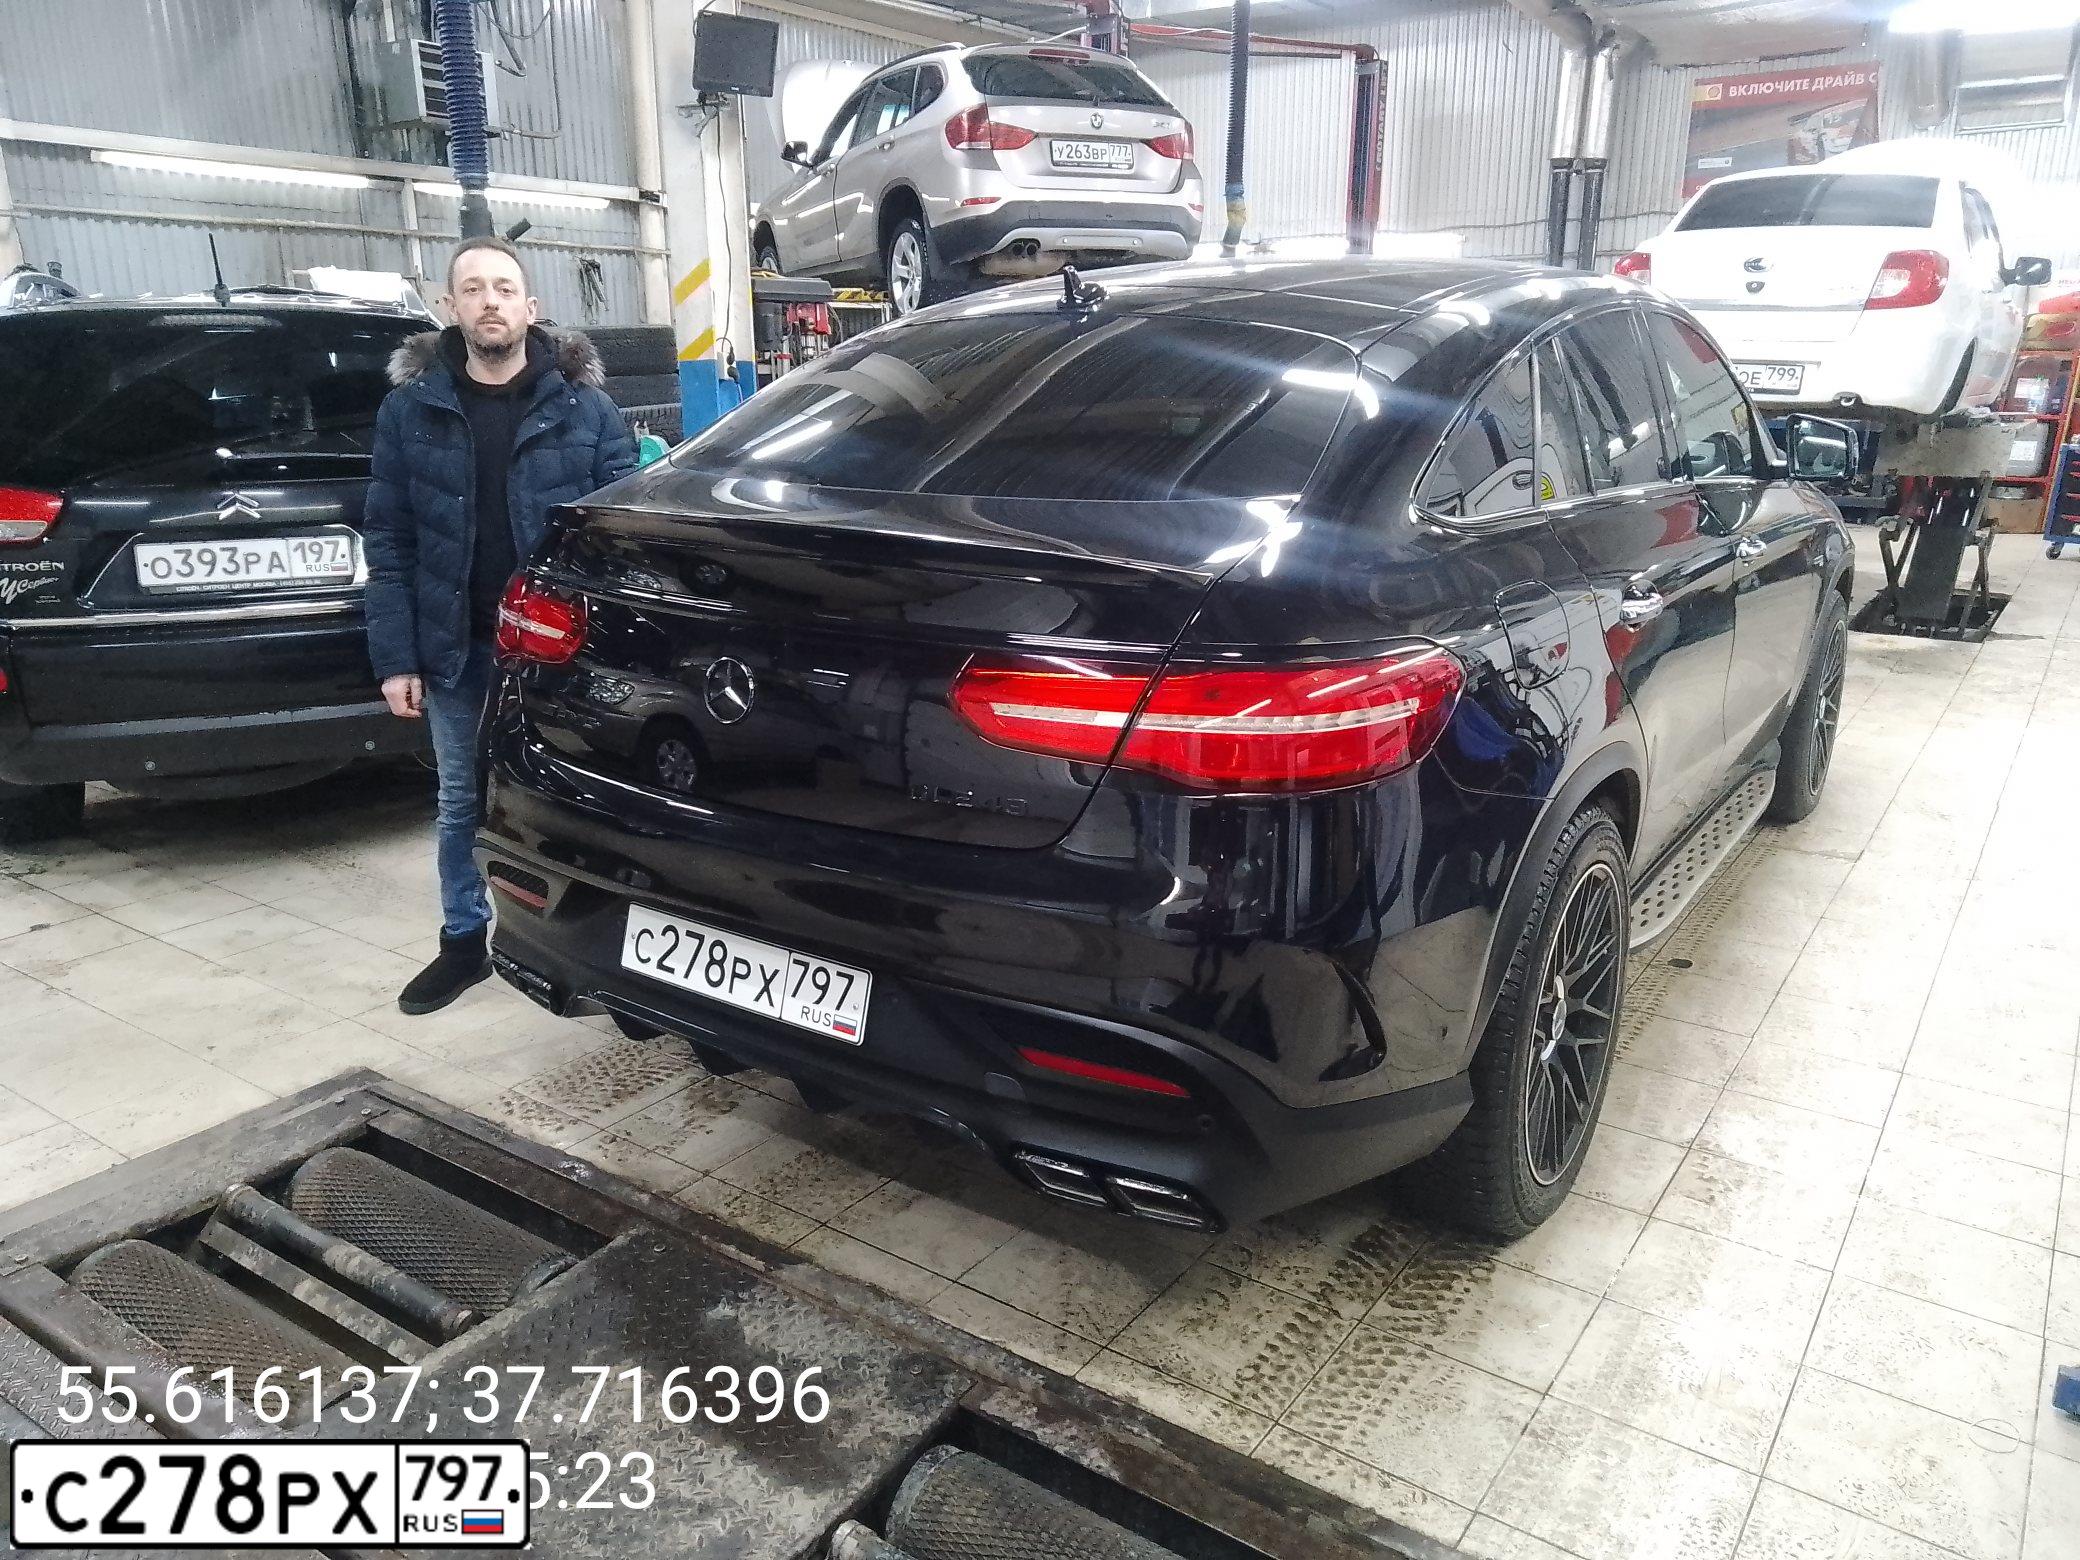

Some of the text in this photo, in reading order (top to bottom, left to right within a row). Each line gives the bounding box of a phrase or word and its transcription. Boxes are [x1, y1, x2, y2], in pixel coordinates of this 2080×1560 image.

[1729, 79, 1811, 97] ВКЛЮЧИТЕ
[1812, 71, 1865, 92] ДРАЙВ
[1057, 144, 1128, 160] У263ВР 777
[1768, 367, 1796, 382] 799
[150, 540, 340, 579] О393РА 197
[305, 563, 329, 572] RUS
[635, 924, 855, 1011] С278РХ 797
[801, 1005, 832, 1027] RUS
